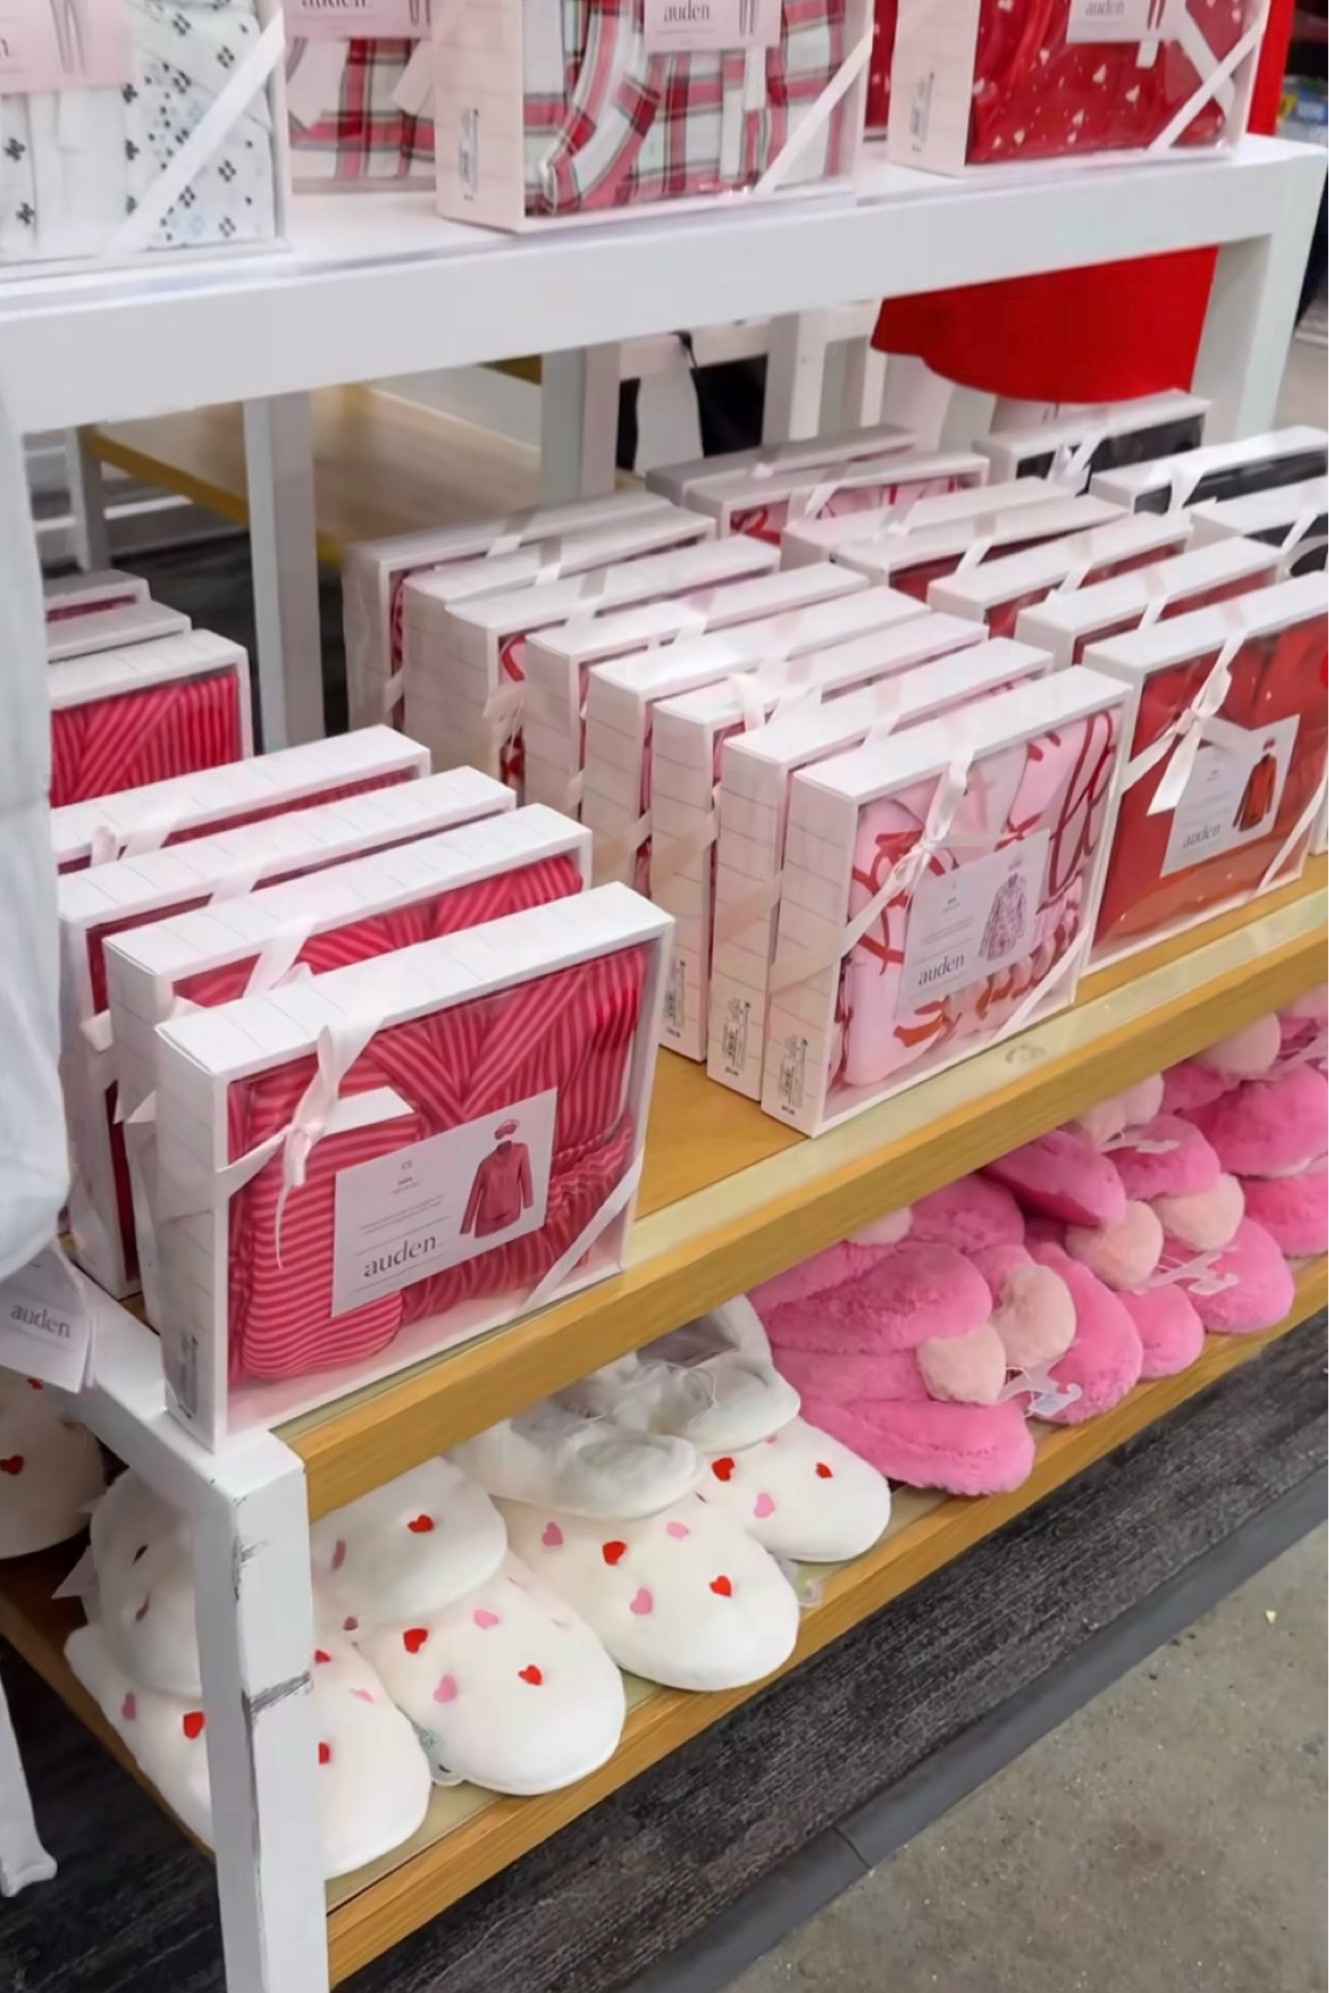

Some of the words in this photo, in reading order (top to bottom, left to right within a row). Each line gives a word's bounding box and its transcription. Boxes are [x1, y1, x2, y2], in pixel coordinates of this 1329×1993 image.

[918, 953, 965, 986] auden
[363, 1235, 437, 1278] auden
[10, 1304, 71, 1338] auden
